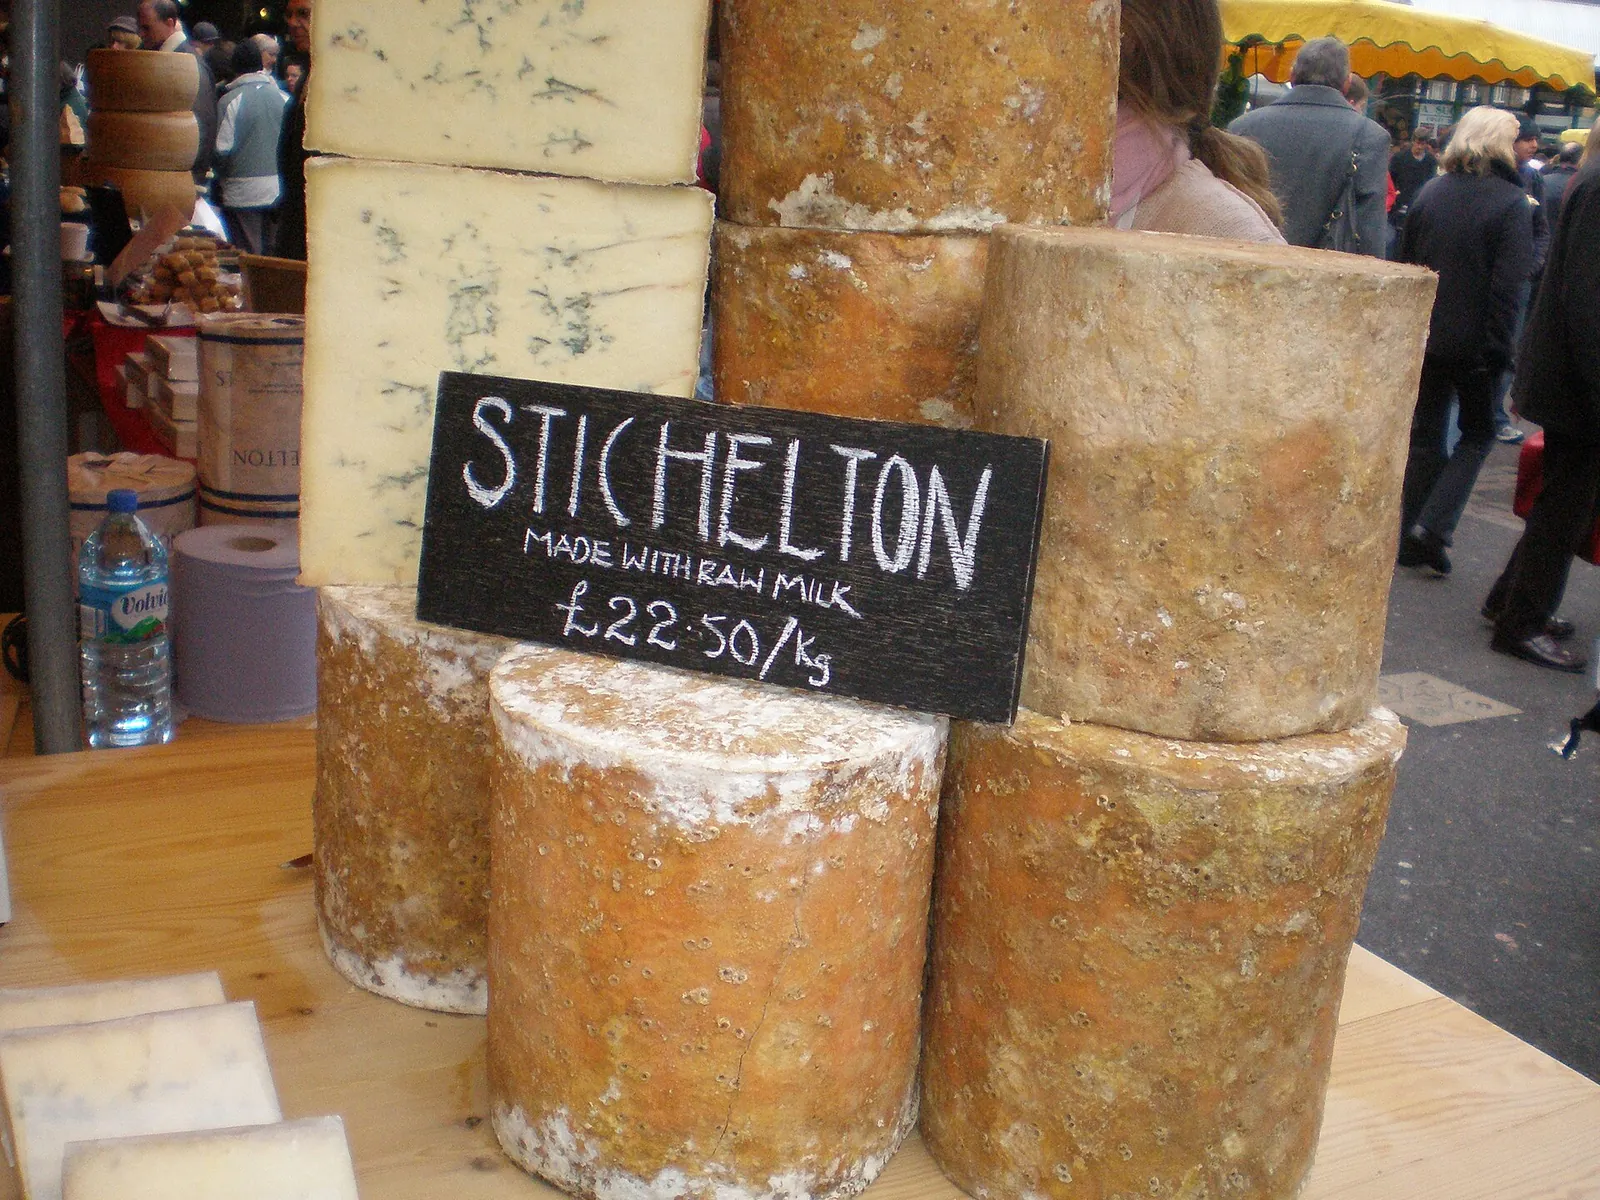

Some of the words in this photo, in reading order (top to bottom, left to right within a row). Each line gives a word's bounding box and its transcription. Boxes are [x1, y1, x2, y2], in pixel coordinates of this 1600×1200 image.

[463, 397, 993, 591] STICHELTON
[523, 527, 613, 567] MADE
[622, 542, 692, 581] WITH
[698, 558, 765, 594] RAW
[772, 572, 863, 620] MILK
